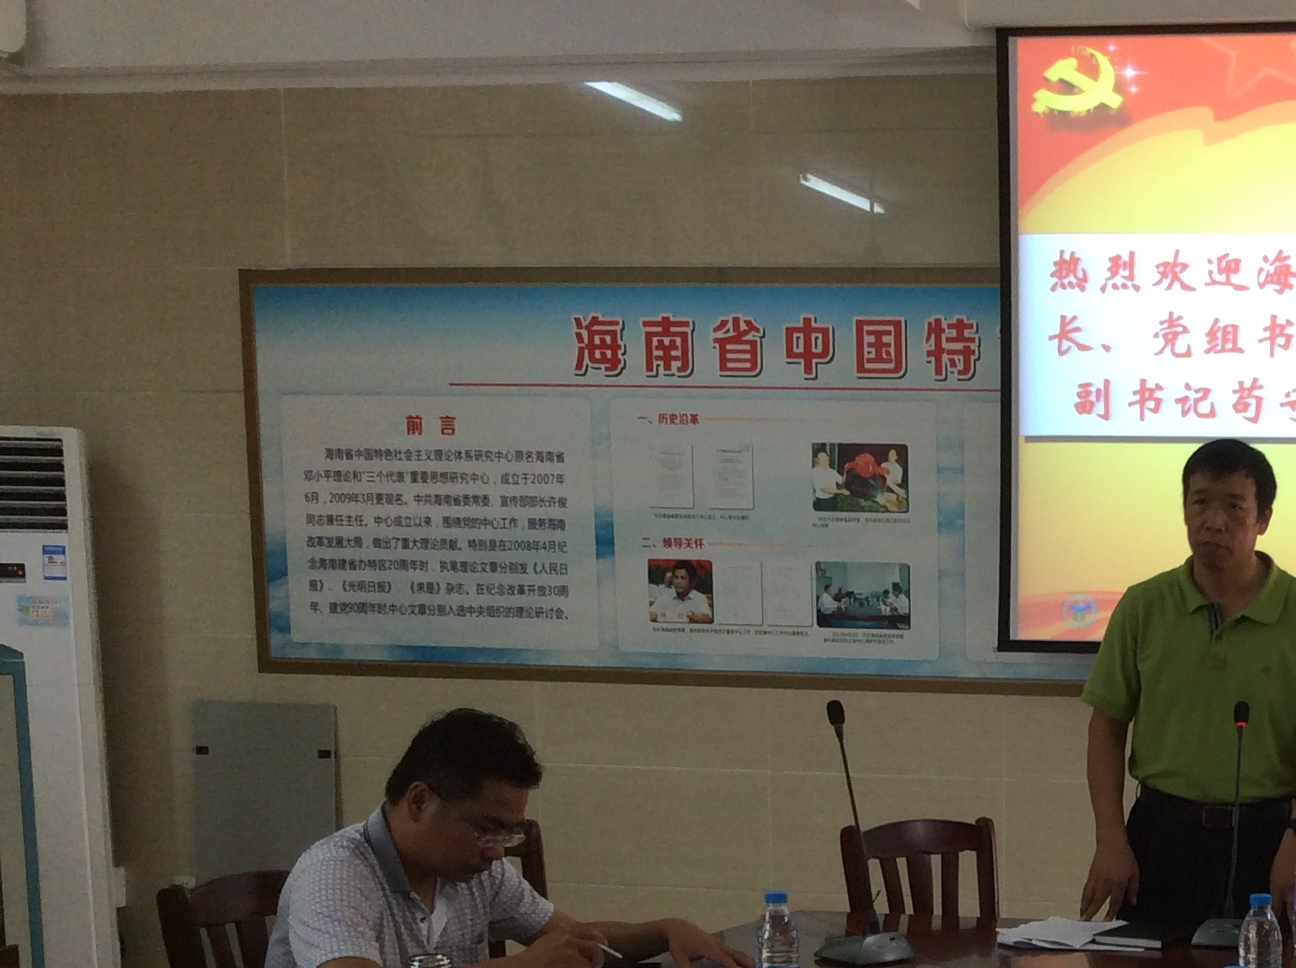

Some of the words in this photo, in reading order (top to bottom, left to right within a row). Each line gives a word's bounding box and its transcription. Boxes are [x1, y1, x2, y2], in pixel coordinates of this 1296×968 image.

[572, 313, 981, 380] 海南省中国特
